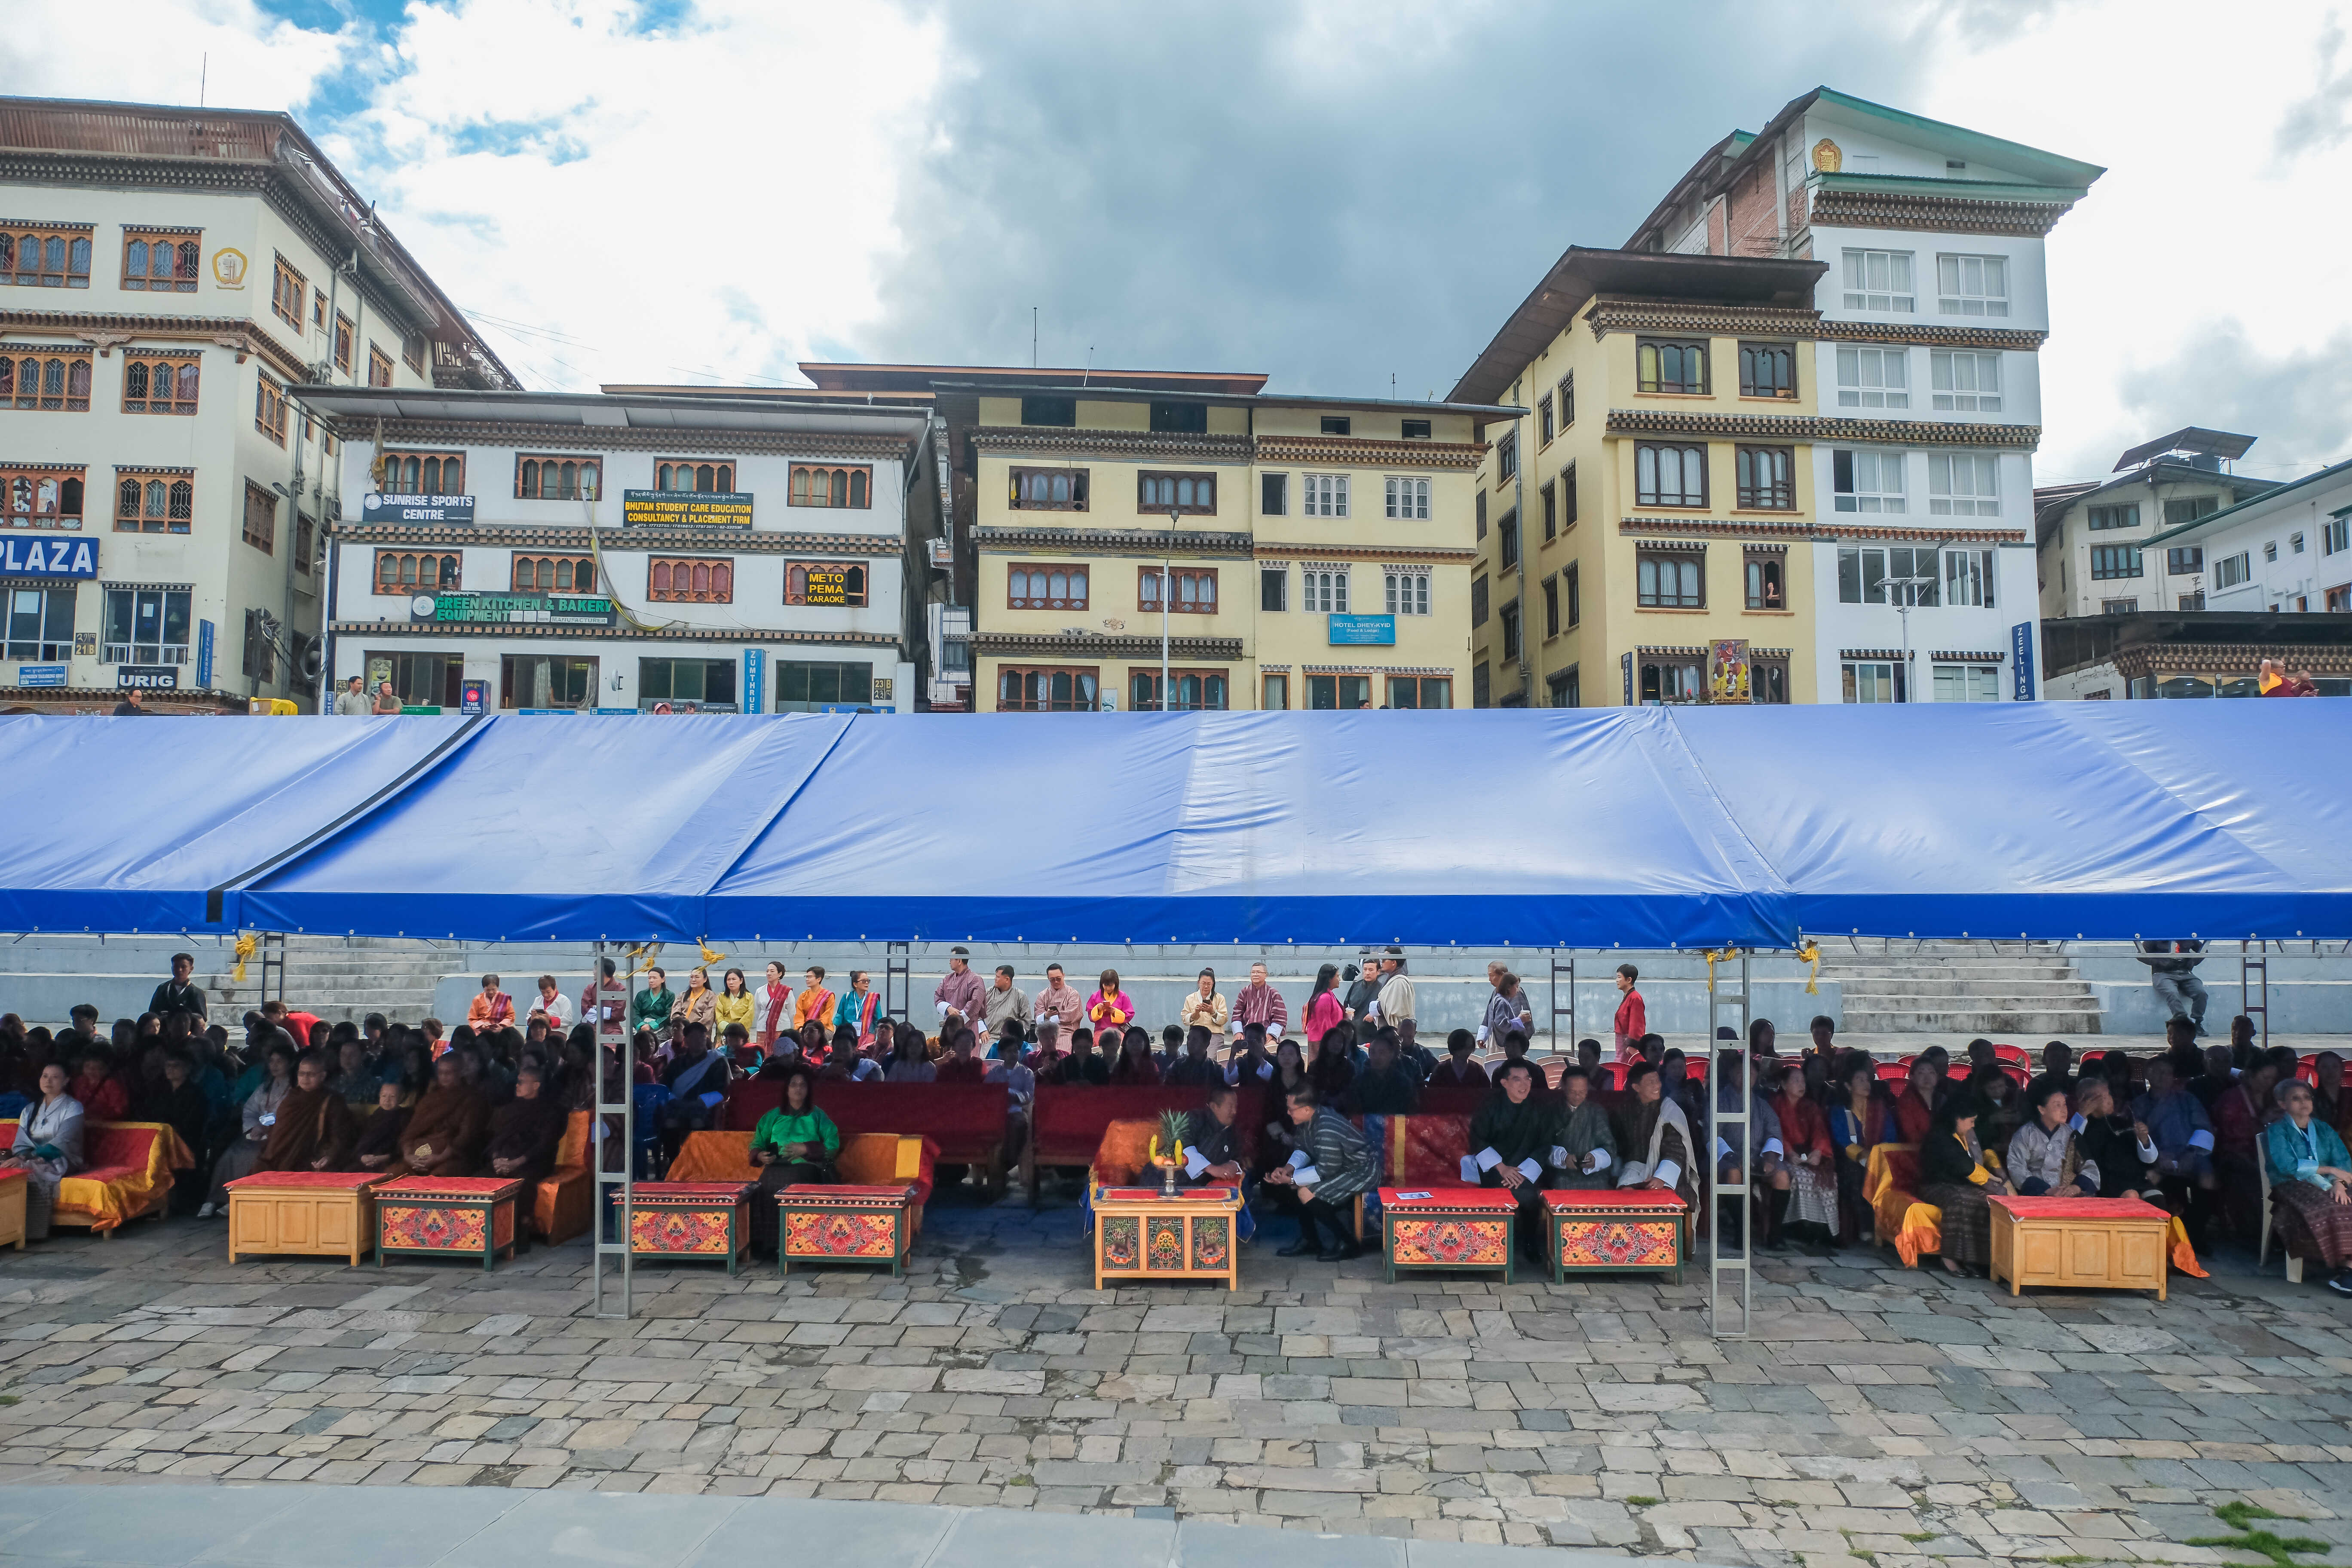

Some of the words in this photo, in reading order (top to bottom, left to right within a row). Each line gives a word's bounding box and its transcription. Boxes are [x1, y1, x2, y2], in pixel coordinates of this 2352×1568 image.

[383, 494, 428, 505] SUNRISE
[431, 496, 473, 507] SPORTS
[625, 502, 654, 511] BHUTAN
[656, 503, 689, 512] STUDENT
[690, 504, 709, 512] CARE
[711, 504, 751, 514] EDUCATION
[403, 509, 444, 520] CENTRE
[628, 513, 679, 523] CONSULTANCY
[682, 514, 687, 523] &
[689, 514, 731, 524] PLACEMENT
[733, 516, 750, 524] FIRM
[0, 541, 93, 573] LAZA
[809, 574, 844, 583] METO
[809, 585, 844, 594] PEMA
[435, 597, 479, 609] GREEN
[482, 597, 541, 611] KITCHEN
[544, 599, 554, 611] &
[558, 599, 612, 612] BAKERY
[437, 609, 510, 622] EQUIPMENT
[76, 644, 86, 655] 21
[89, 644, 95, 654] B
[2018, 627, 2026, 694] ZEELING
[119, 674, 174, 687] URIG
[886, 679, 891, 689] B
